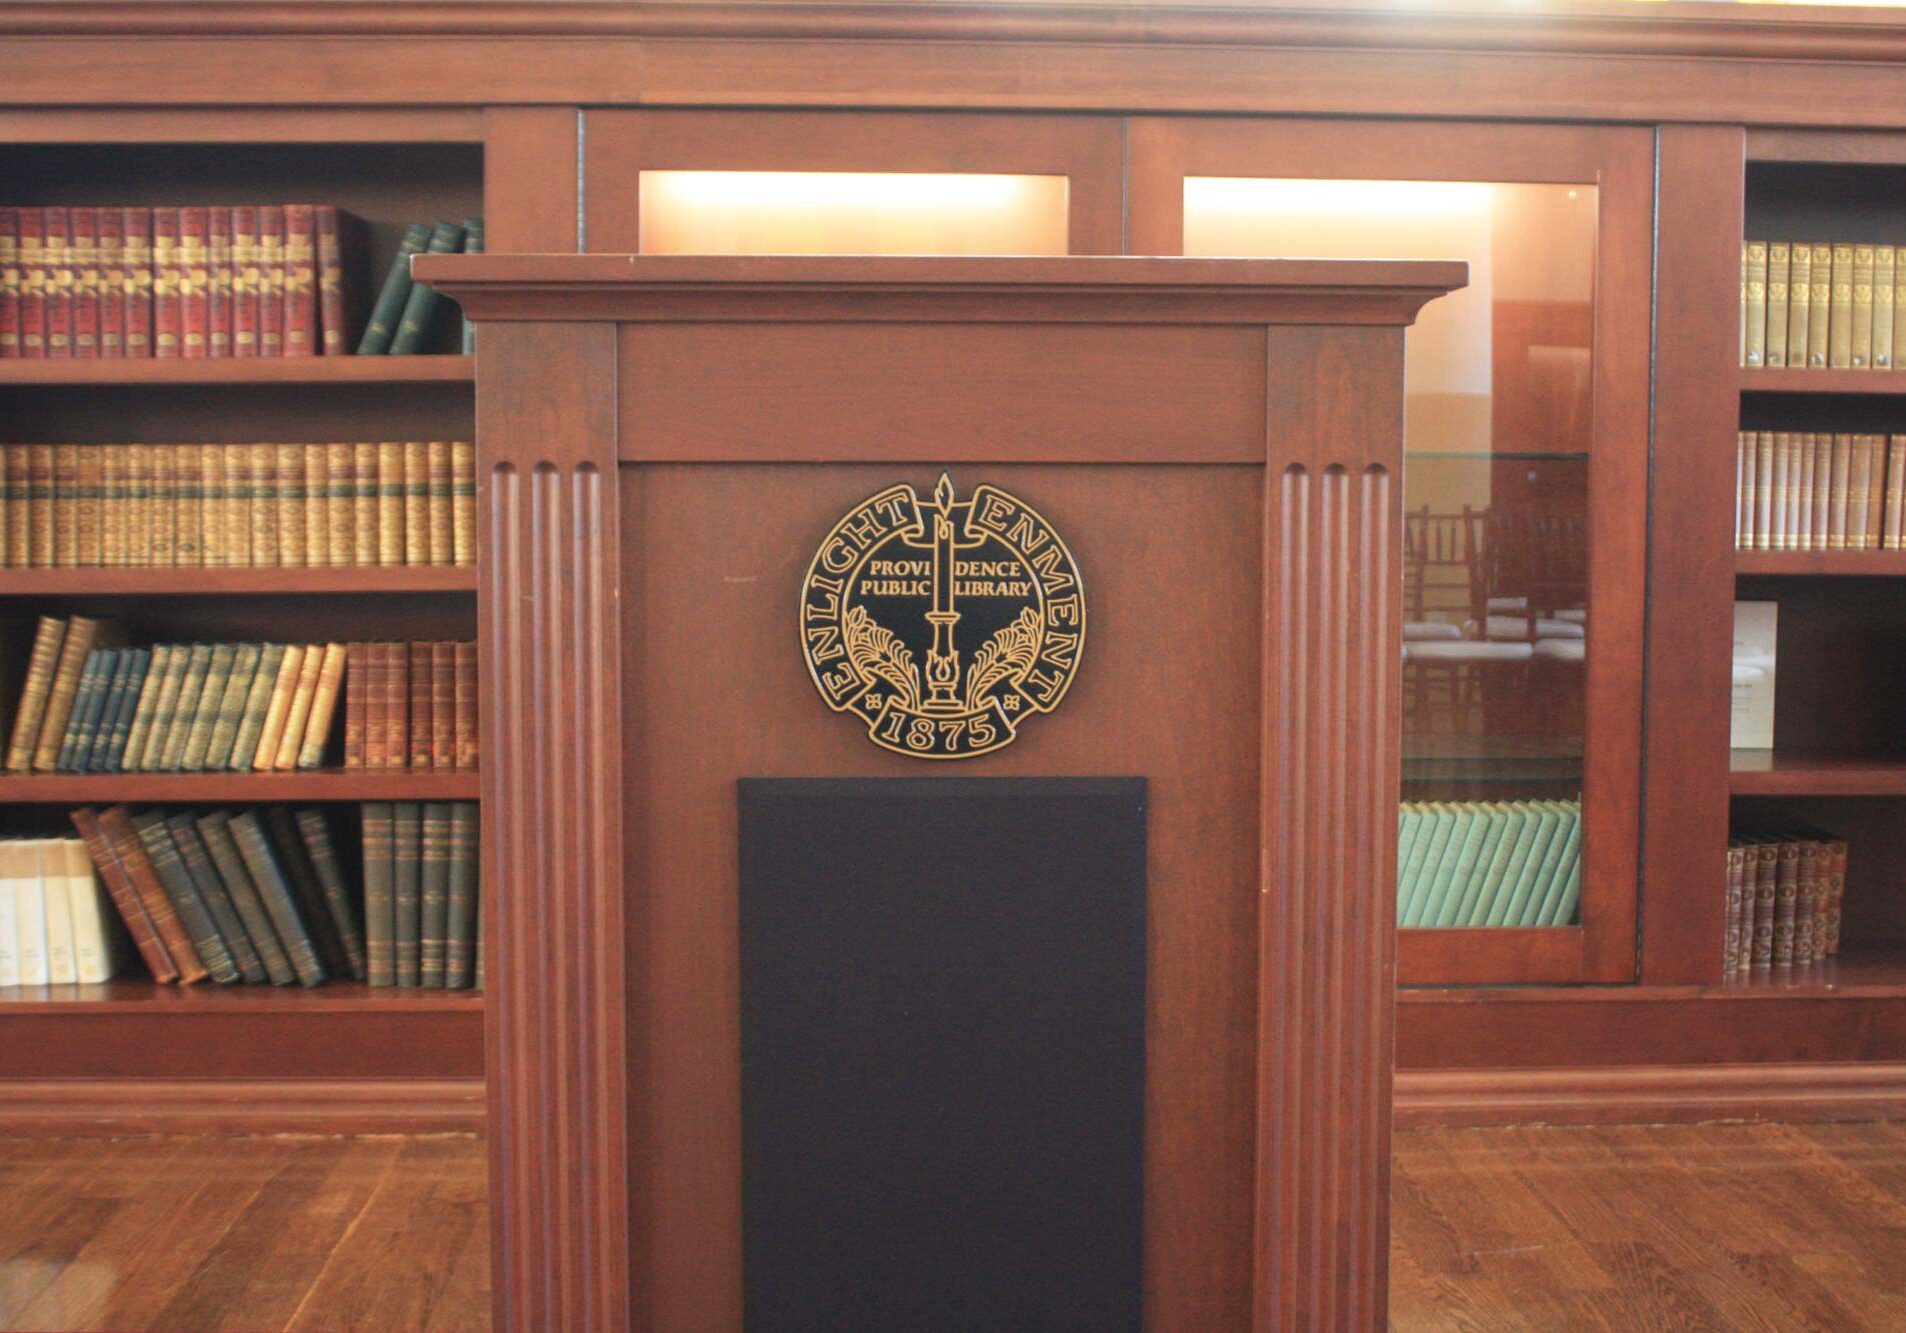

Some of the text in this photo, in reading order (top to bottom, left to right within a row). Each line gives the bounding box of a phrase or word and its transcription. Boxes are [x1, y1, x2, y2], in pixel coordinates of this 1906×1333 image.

[870, 560, 1021, 576] PROVI DENCE
[860, 580, 1033, 597] PUBLIC LIBRARY
[881, 711, 997, 751] 1875
